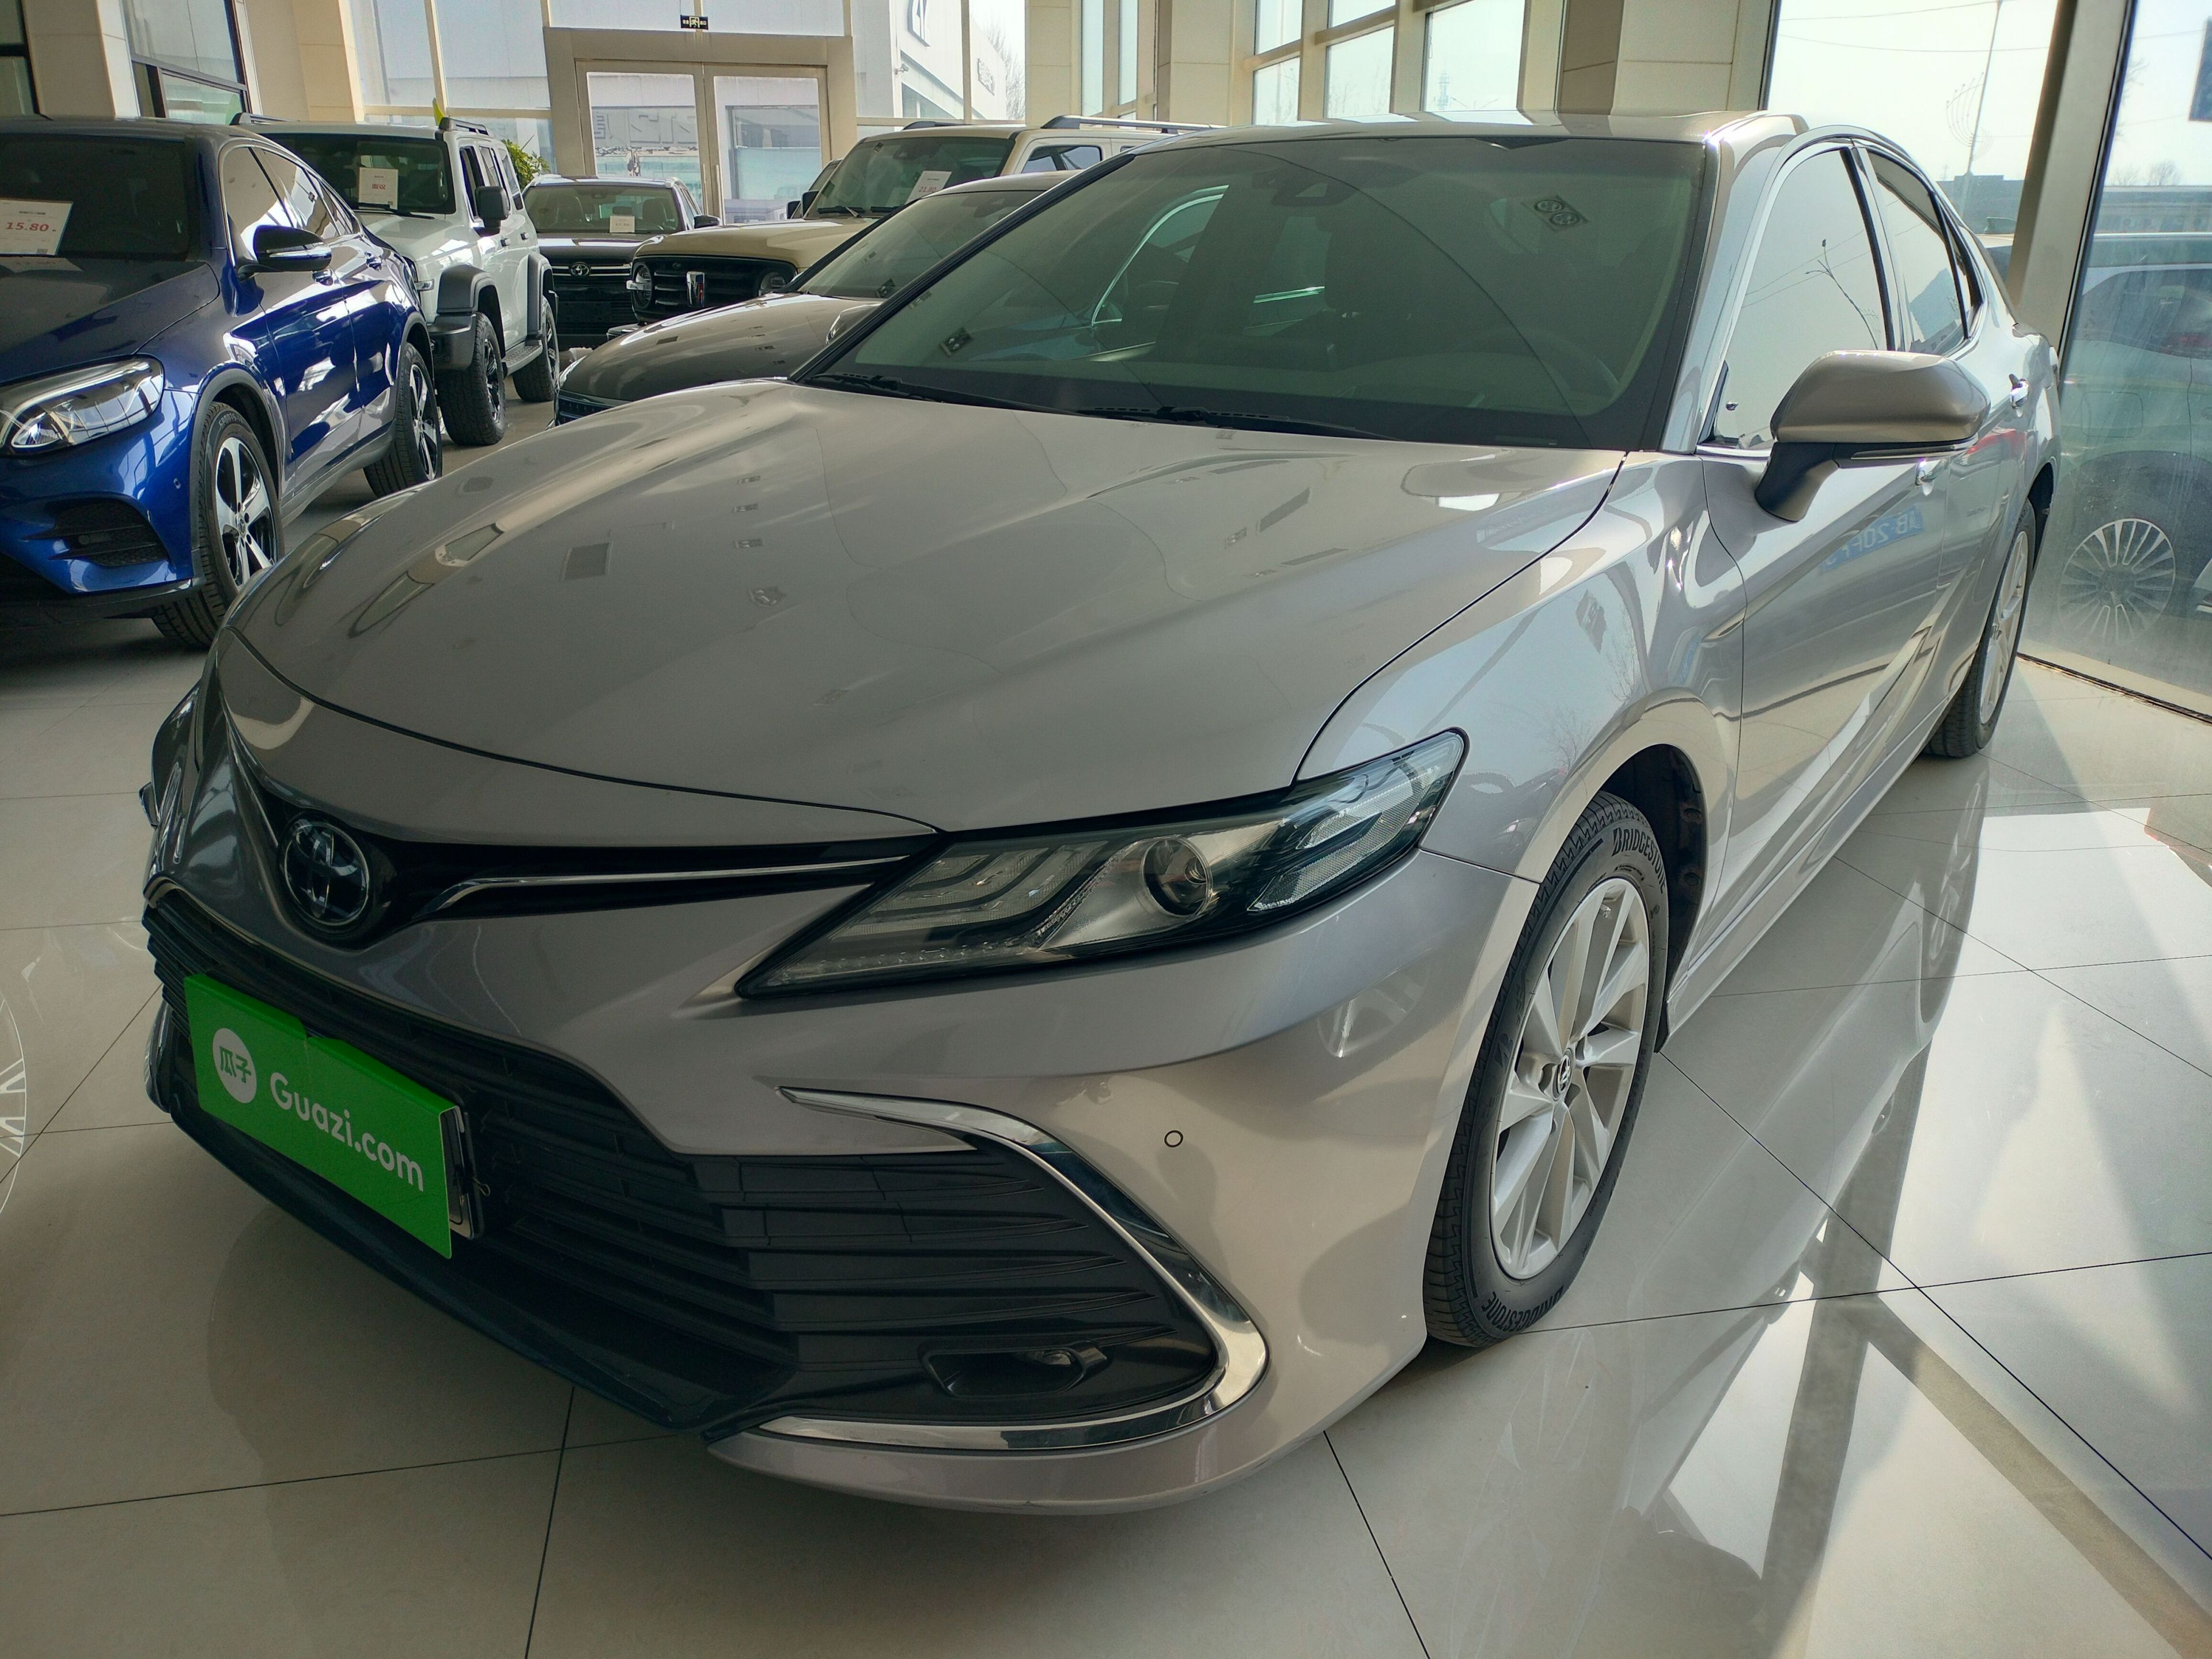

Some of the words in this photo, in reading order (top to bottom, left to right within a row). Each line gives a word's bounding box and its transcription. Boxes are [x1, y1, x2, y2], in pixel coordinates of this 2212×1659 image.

[1611, 827, 1666, 894] BRIDGESTONE
[219, 1046, 252, 1084] 瓜子
[270, 1072, 424, 1192] Guazi.com
